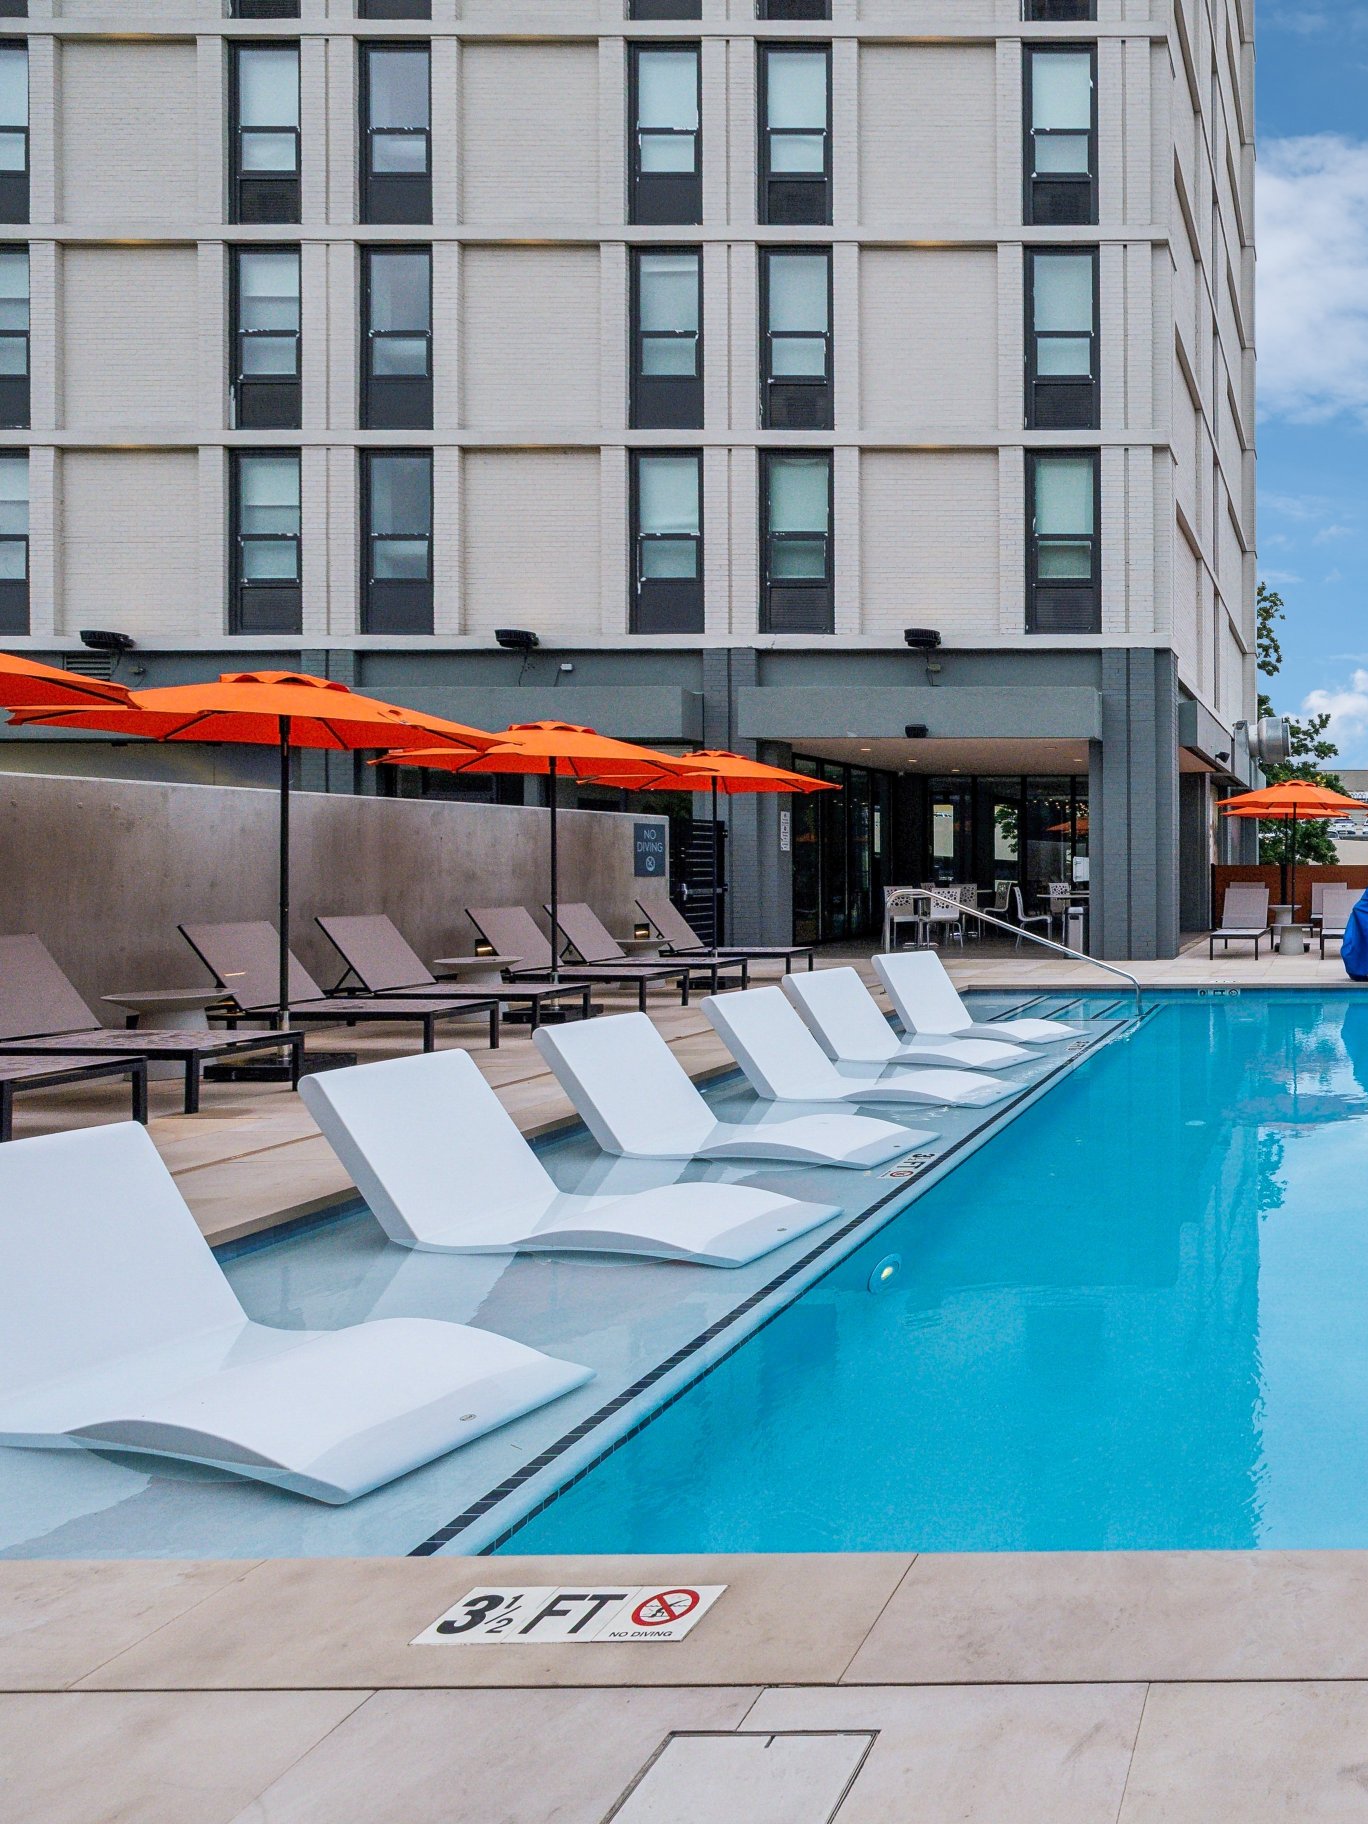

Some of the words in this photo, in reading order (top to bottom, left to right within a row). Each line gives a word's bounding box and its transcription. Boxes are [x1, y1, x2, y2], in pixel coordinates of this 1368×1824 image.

[644, 829, 656, 840] NO
[637, 842, 664, 852] DIVING
[517, 1593, 629, 1635] FT
[630, 1630, 673, 1638] DIVING
